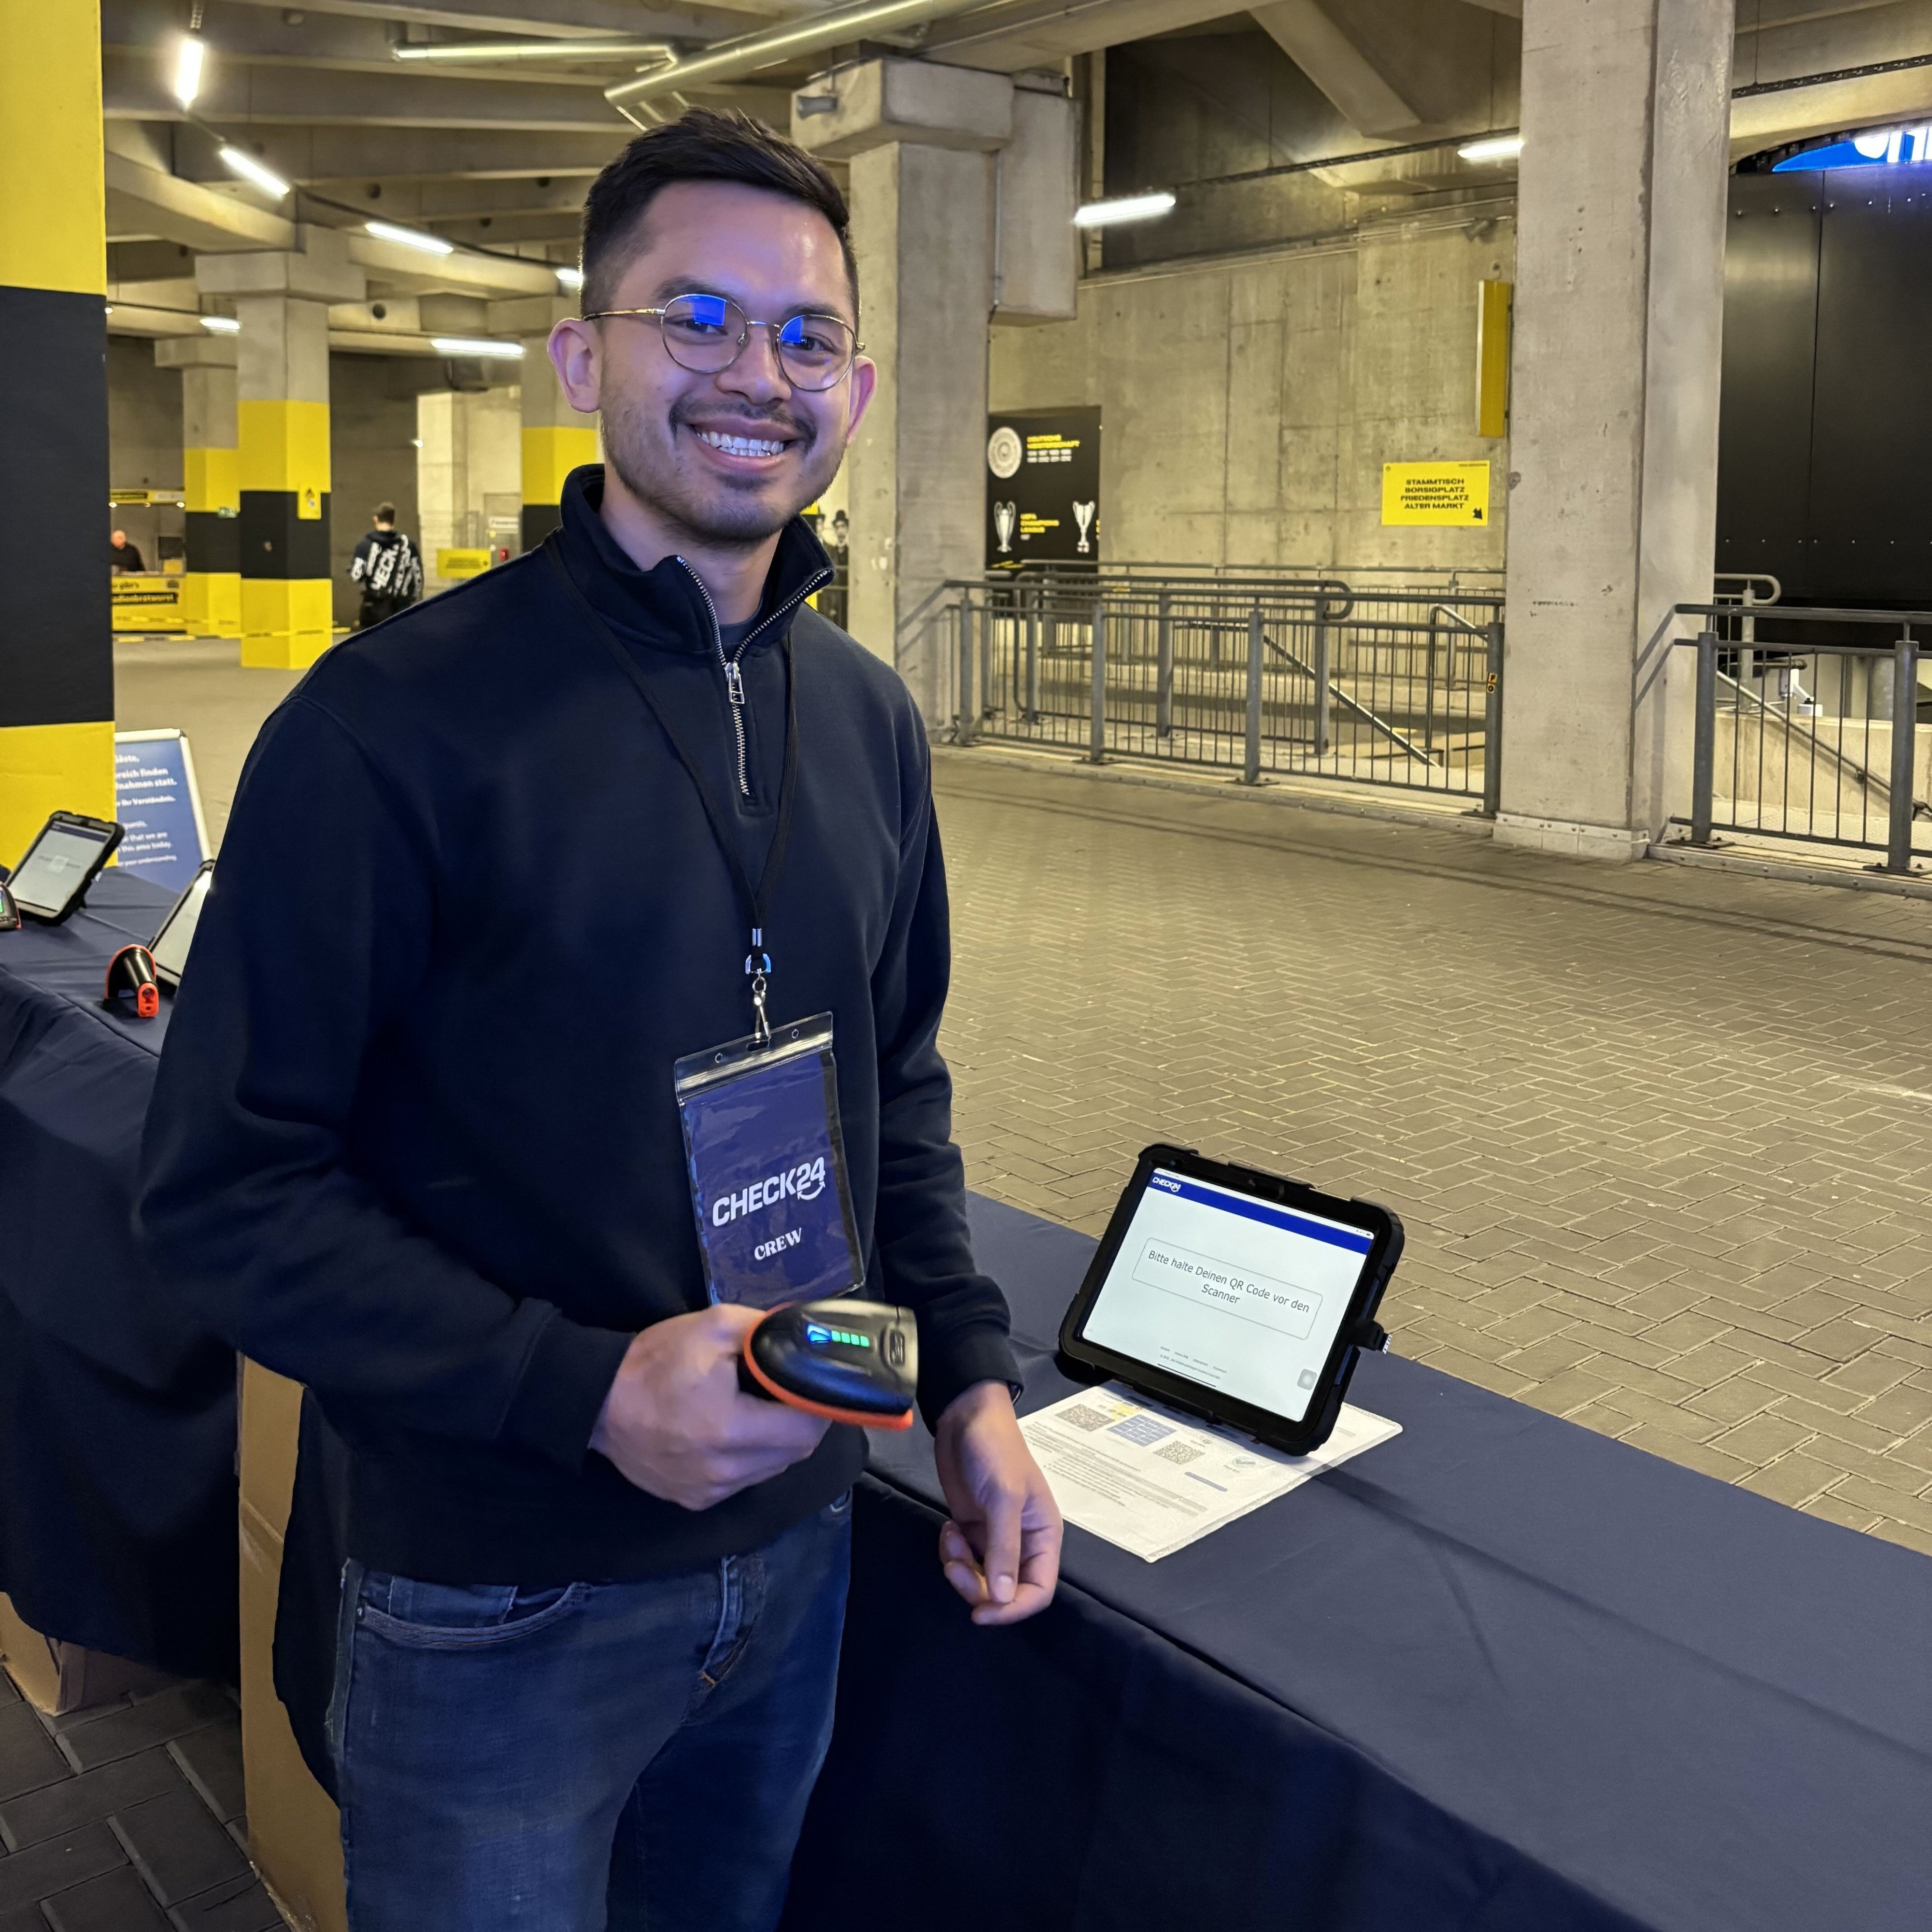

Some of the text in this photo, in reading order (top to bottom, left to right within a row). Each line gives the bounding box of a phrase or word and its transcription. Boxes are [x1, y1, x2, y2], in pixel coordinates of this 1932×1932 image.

[713, 1157, 825, 1226] CHECK24
[754, 1228, 802, 1260] CREW
[1149, 1250, 1309, 1313] Bitte halte Deinen QR Code vor den
[1202, 1284, 1240, 1304] Scanner
